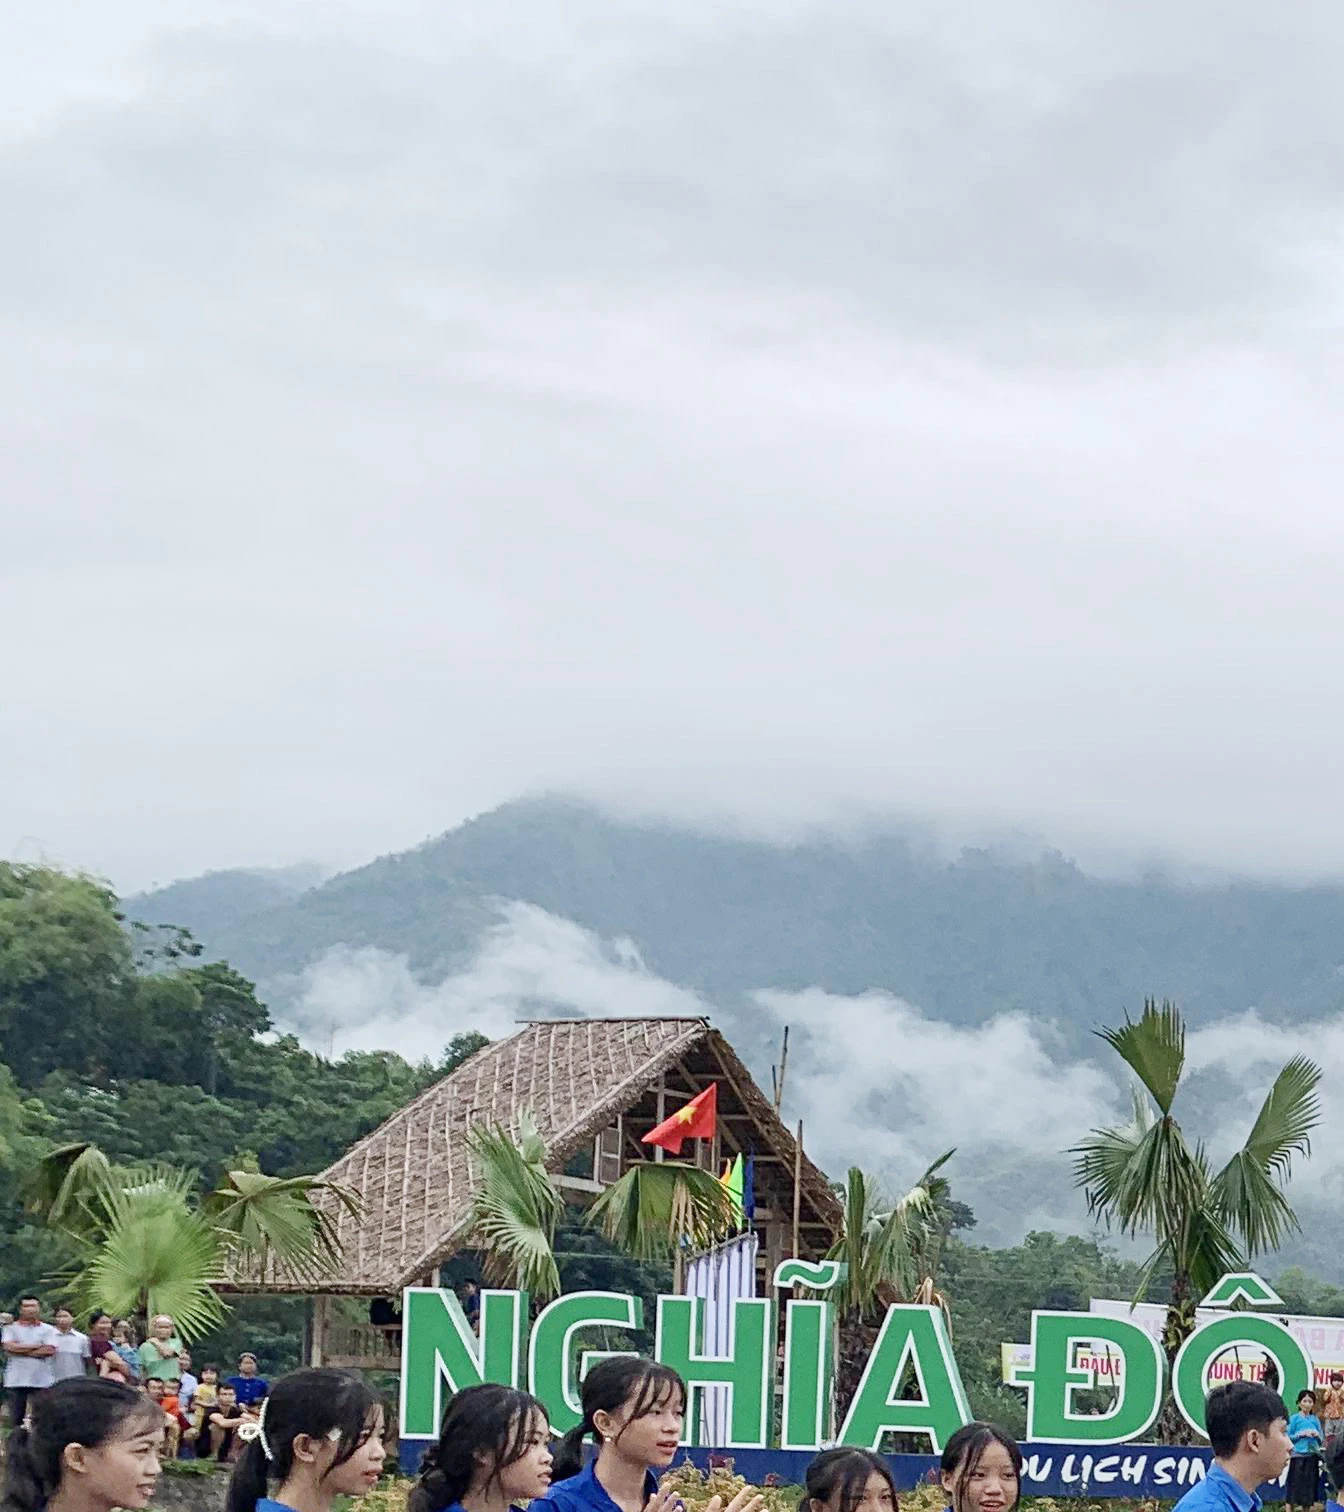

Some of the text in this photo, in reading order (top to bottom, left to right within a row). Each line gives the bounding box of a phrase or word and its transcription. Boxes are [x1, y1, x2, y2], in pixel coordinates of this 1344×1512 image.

[399, 1258, 1312, 1457] NGHĨA ĐÔ
[1061, 1454, 1148, 1490] LỊCH
[1153, 1456, 1213, 1486] SIN
